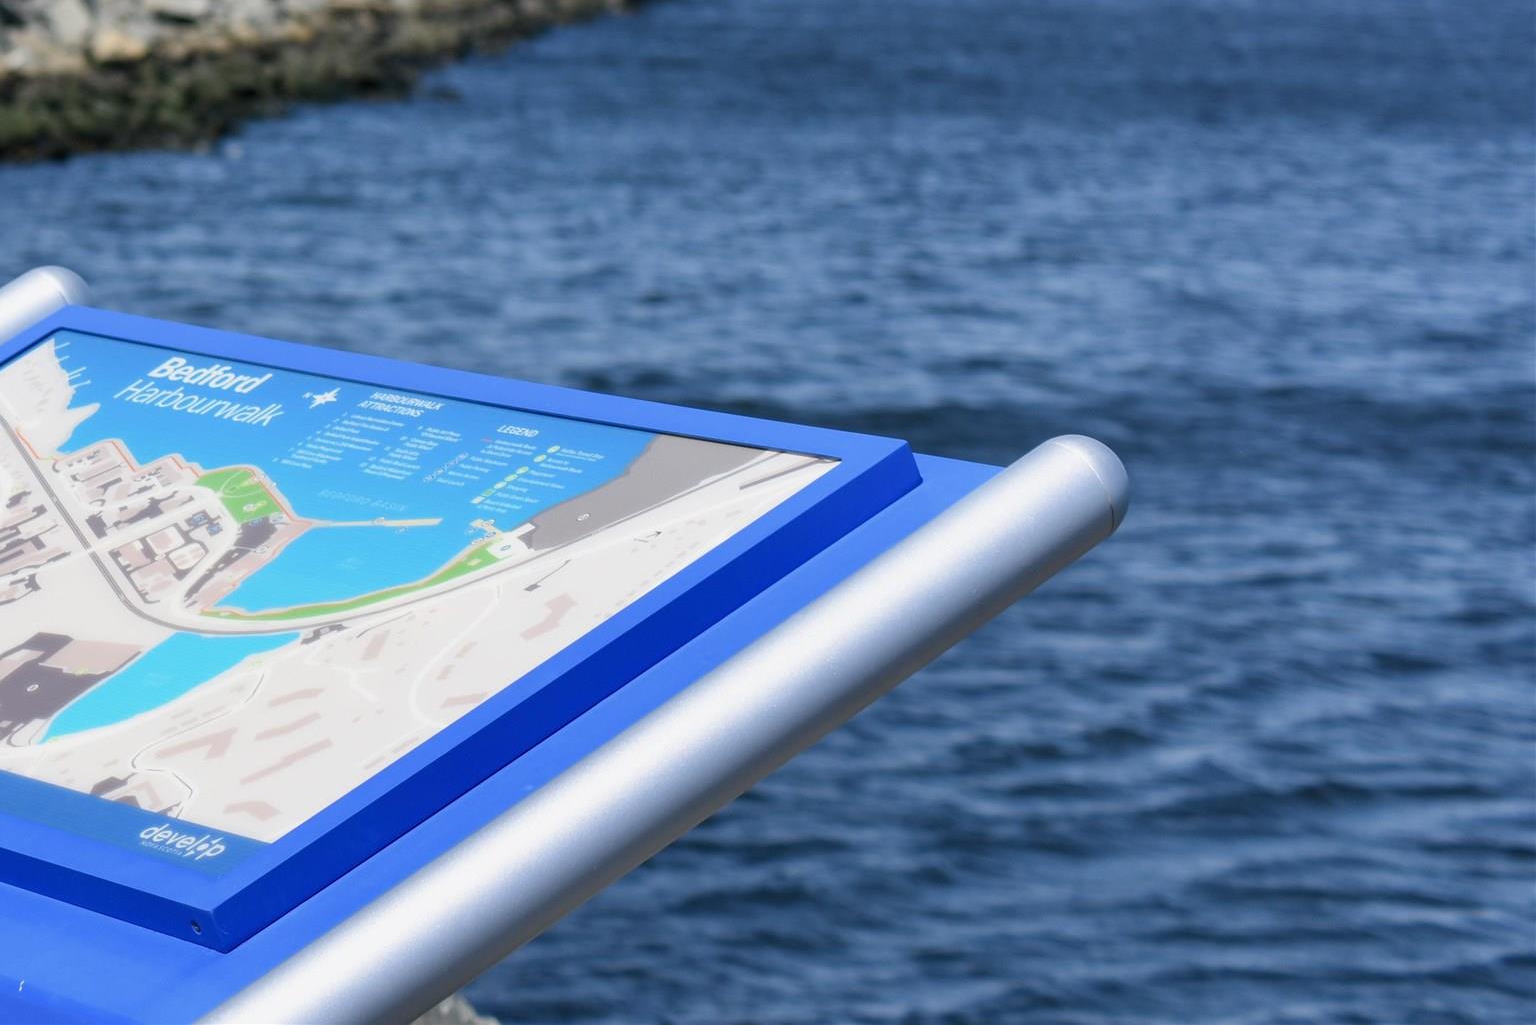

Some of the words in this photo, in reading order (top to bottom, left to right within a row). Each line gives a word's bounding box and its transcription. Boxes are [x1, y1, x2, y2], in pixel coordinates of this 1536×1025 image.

[147, 357, 273, 394] Bedford
[113, 379, 286, 426] Harbourwalk
[357, 400, 425, 417] ATTRACTIONS
[370, 391, 445, 411] HARBOURWALK
[497, 425, 539, 438] LEGEND
